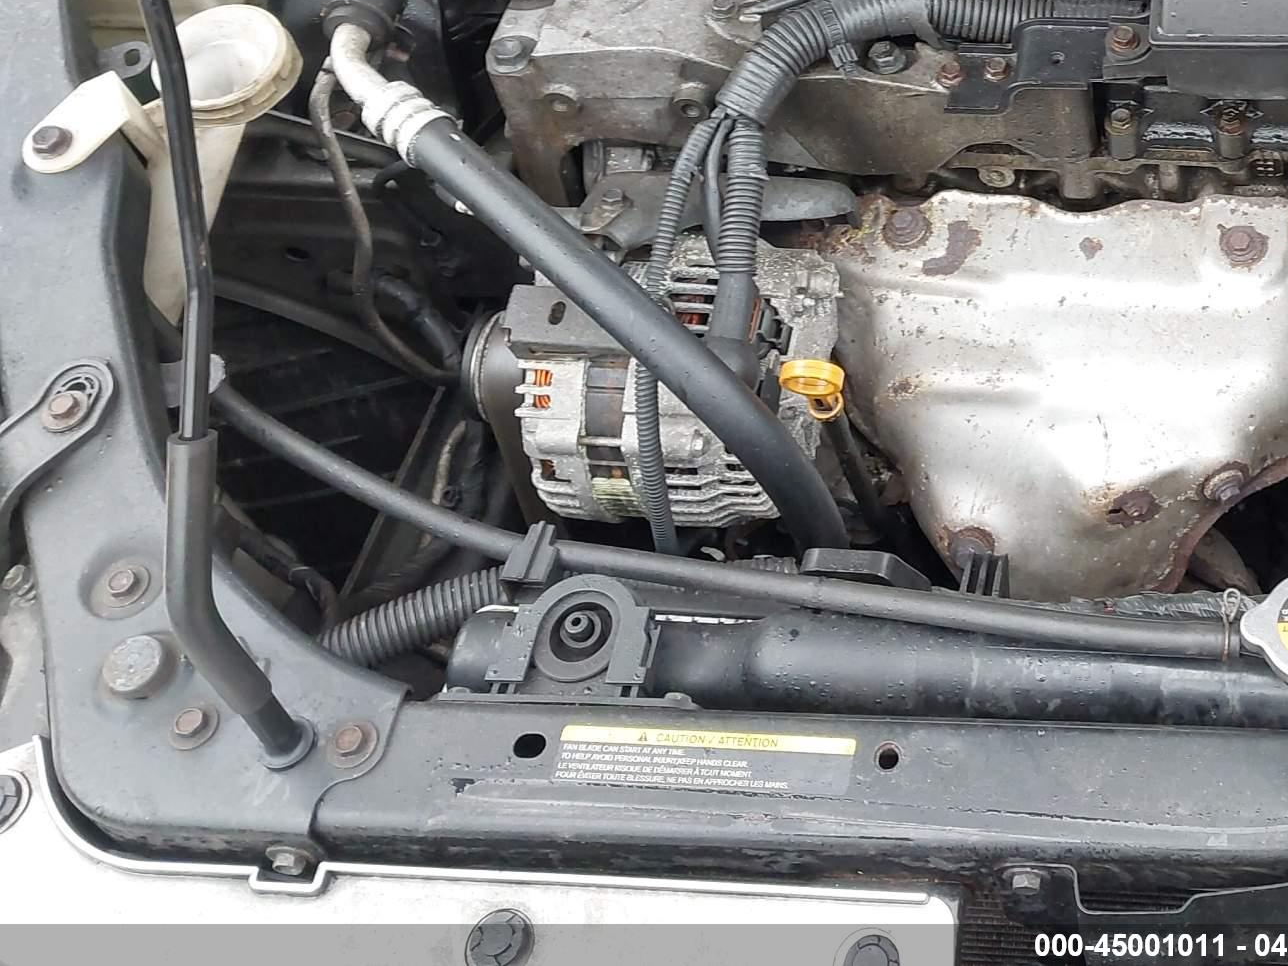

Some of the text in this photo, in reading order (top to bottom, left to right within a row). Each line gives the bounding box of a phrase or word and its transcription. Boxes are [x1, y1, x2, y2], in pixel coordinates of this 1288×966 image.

[656, 733, 706, 744] CAUTION
[718, 736, 778, 747] ATTENTION
[614, 754, 652, 762] PERSONAL
